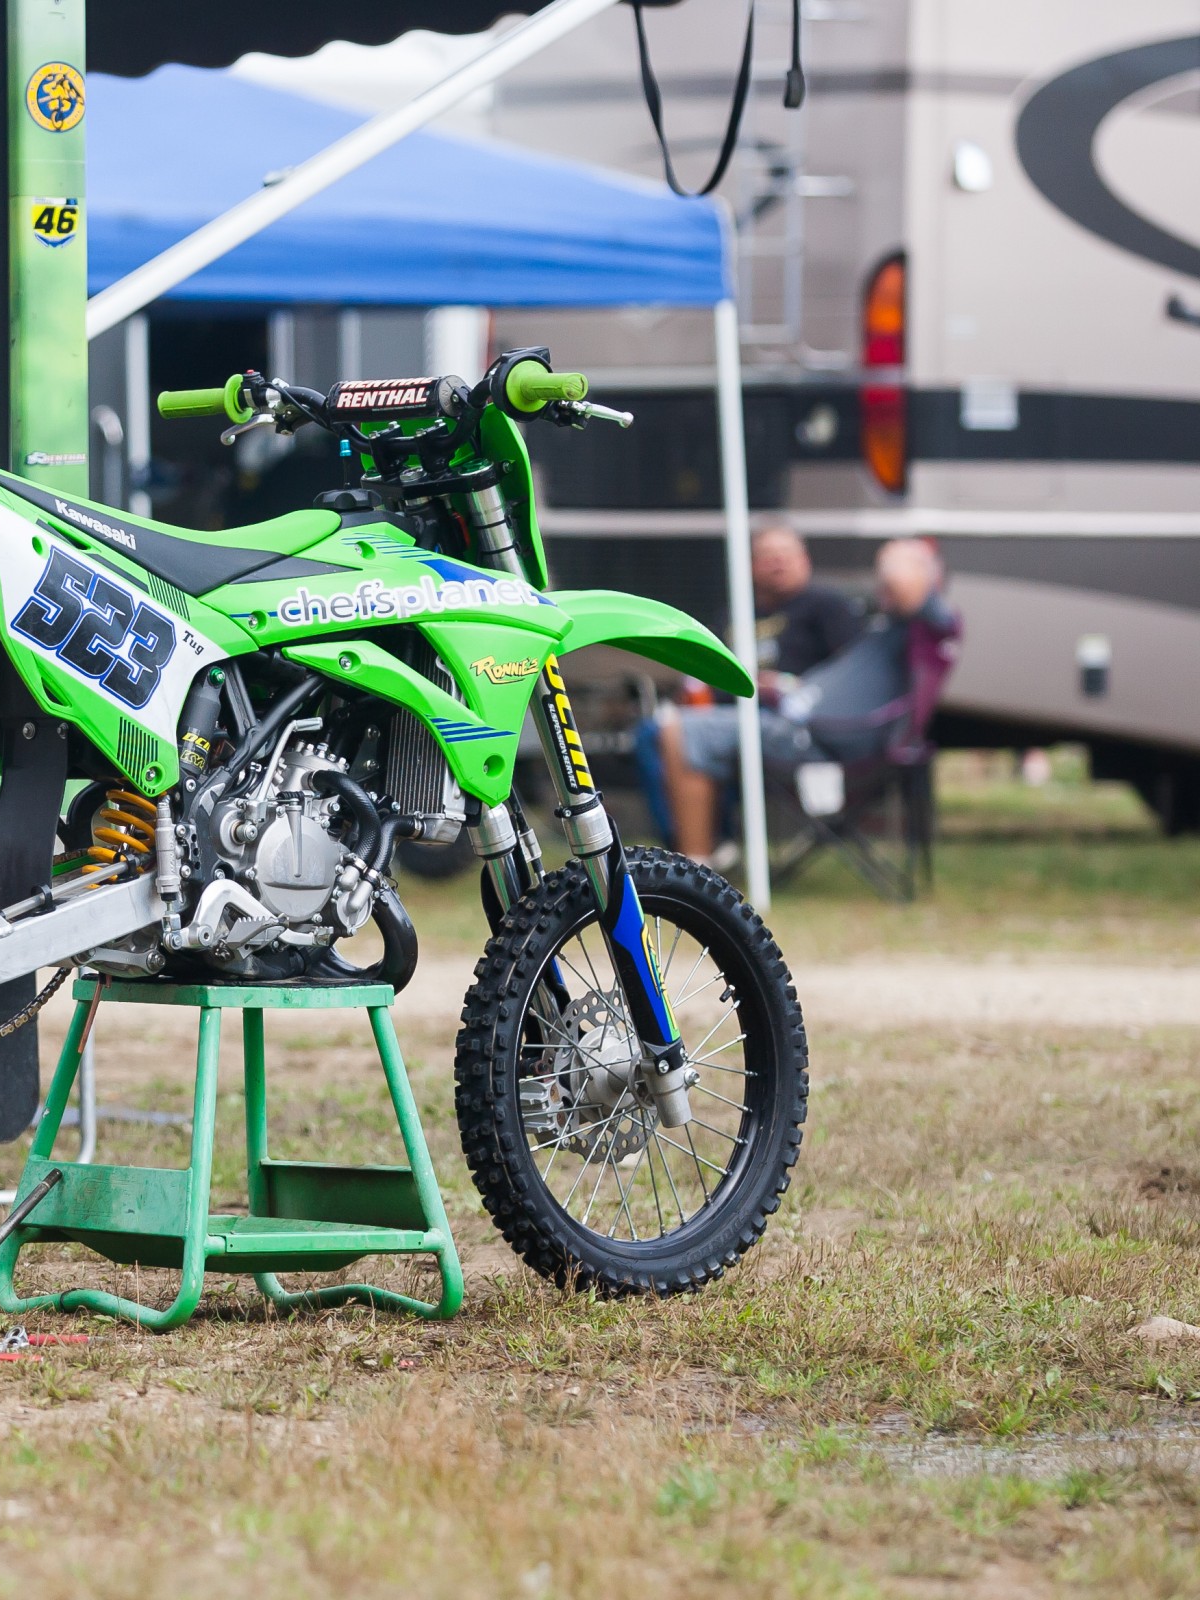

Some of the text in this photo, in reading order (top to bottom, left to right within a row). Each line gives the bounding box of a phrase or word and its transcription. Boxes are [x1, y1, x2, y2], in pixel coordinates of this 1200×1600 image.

[34, 206, 77, 234] 46
[336, 386, 428, 409] RENTHAL
[55, 498, 137, 550] Kawasaki
[11, 544, 177, 710] 523
[182, 630, 205, 656] Tug
[548, 703, 578, 789] SUSPENSION SERVICE
